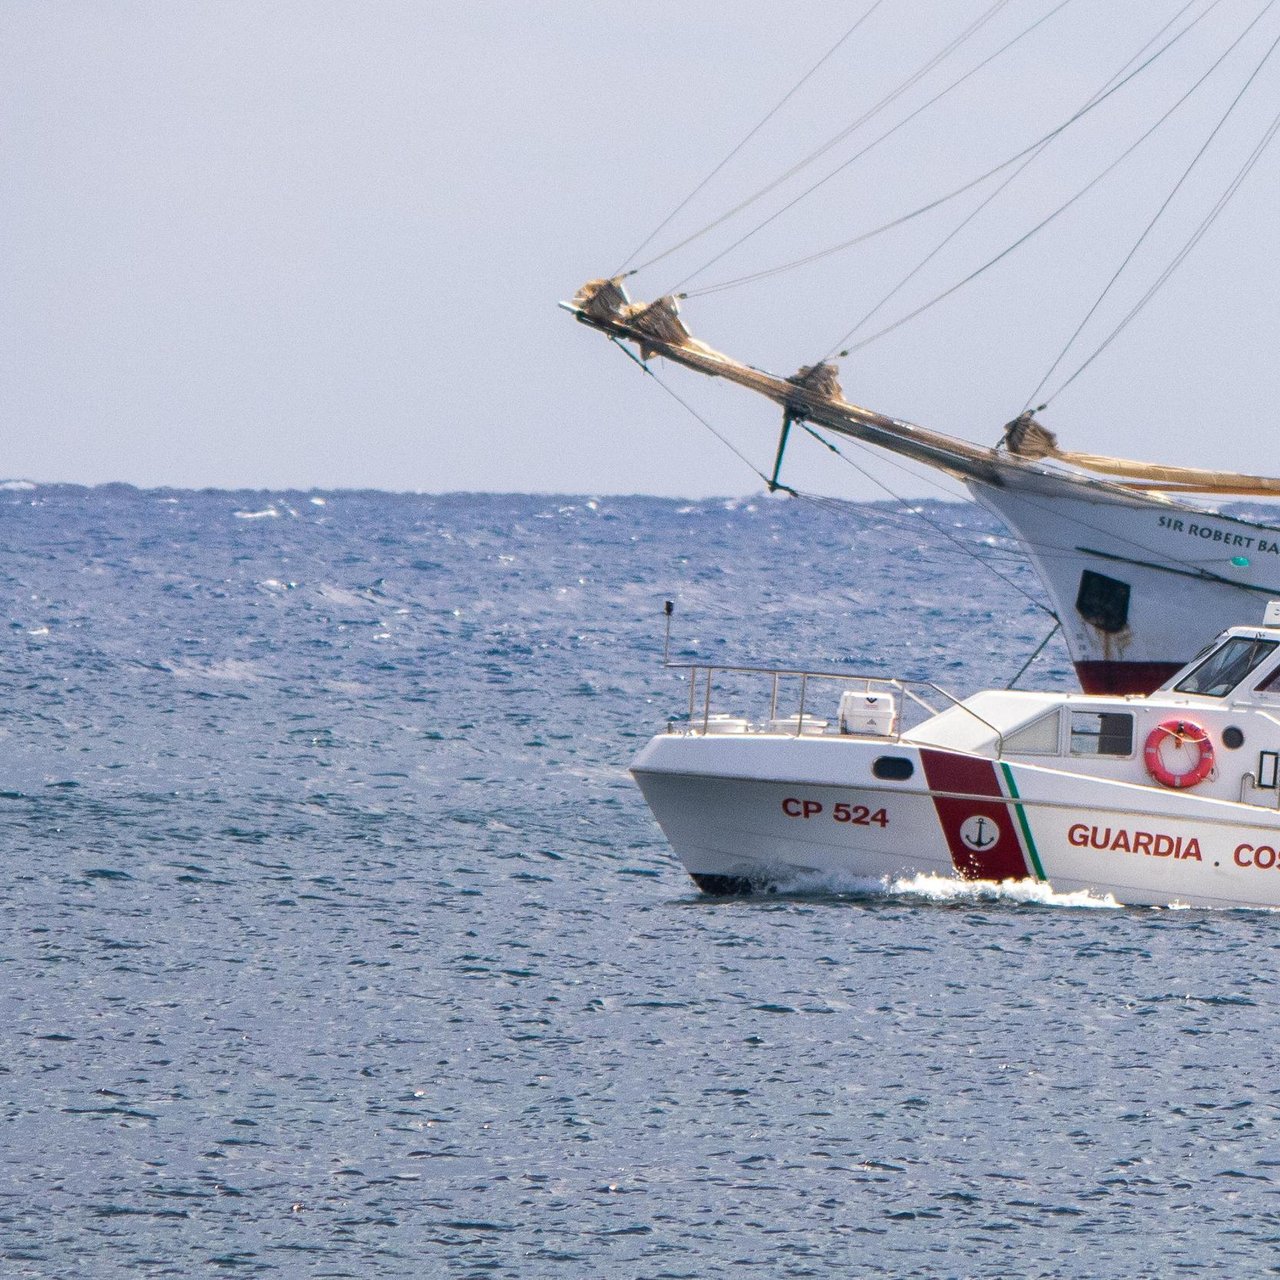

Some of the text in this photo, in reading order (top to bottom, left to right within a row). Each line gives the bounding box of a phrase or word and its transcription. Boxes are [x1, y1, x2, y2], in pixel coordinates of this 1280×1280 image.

[1158, 516, 1185, 532] SIR
[1188, 524, 1255, 548] ROBERT
[781, 798, 890, 828] CP 524
[1067, 823, 1203, 862] GUARDIA
